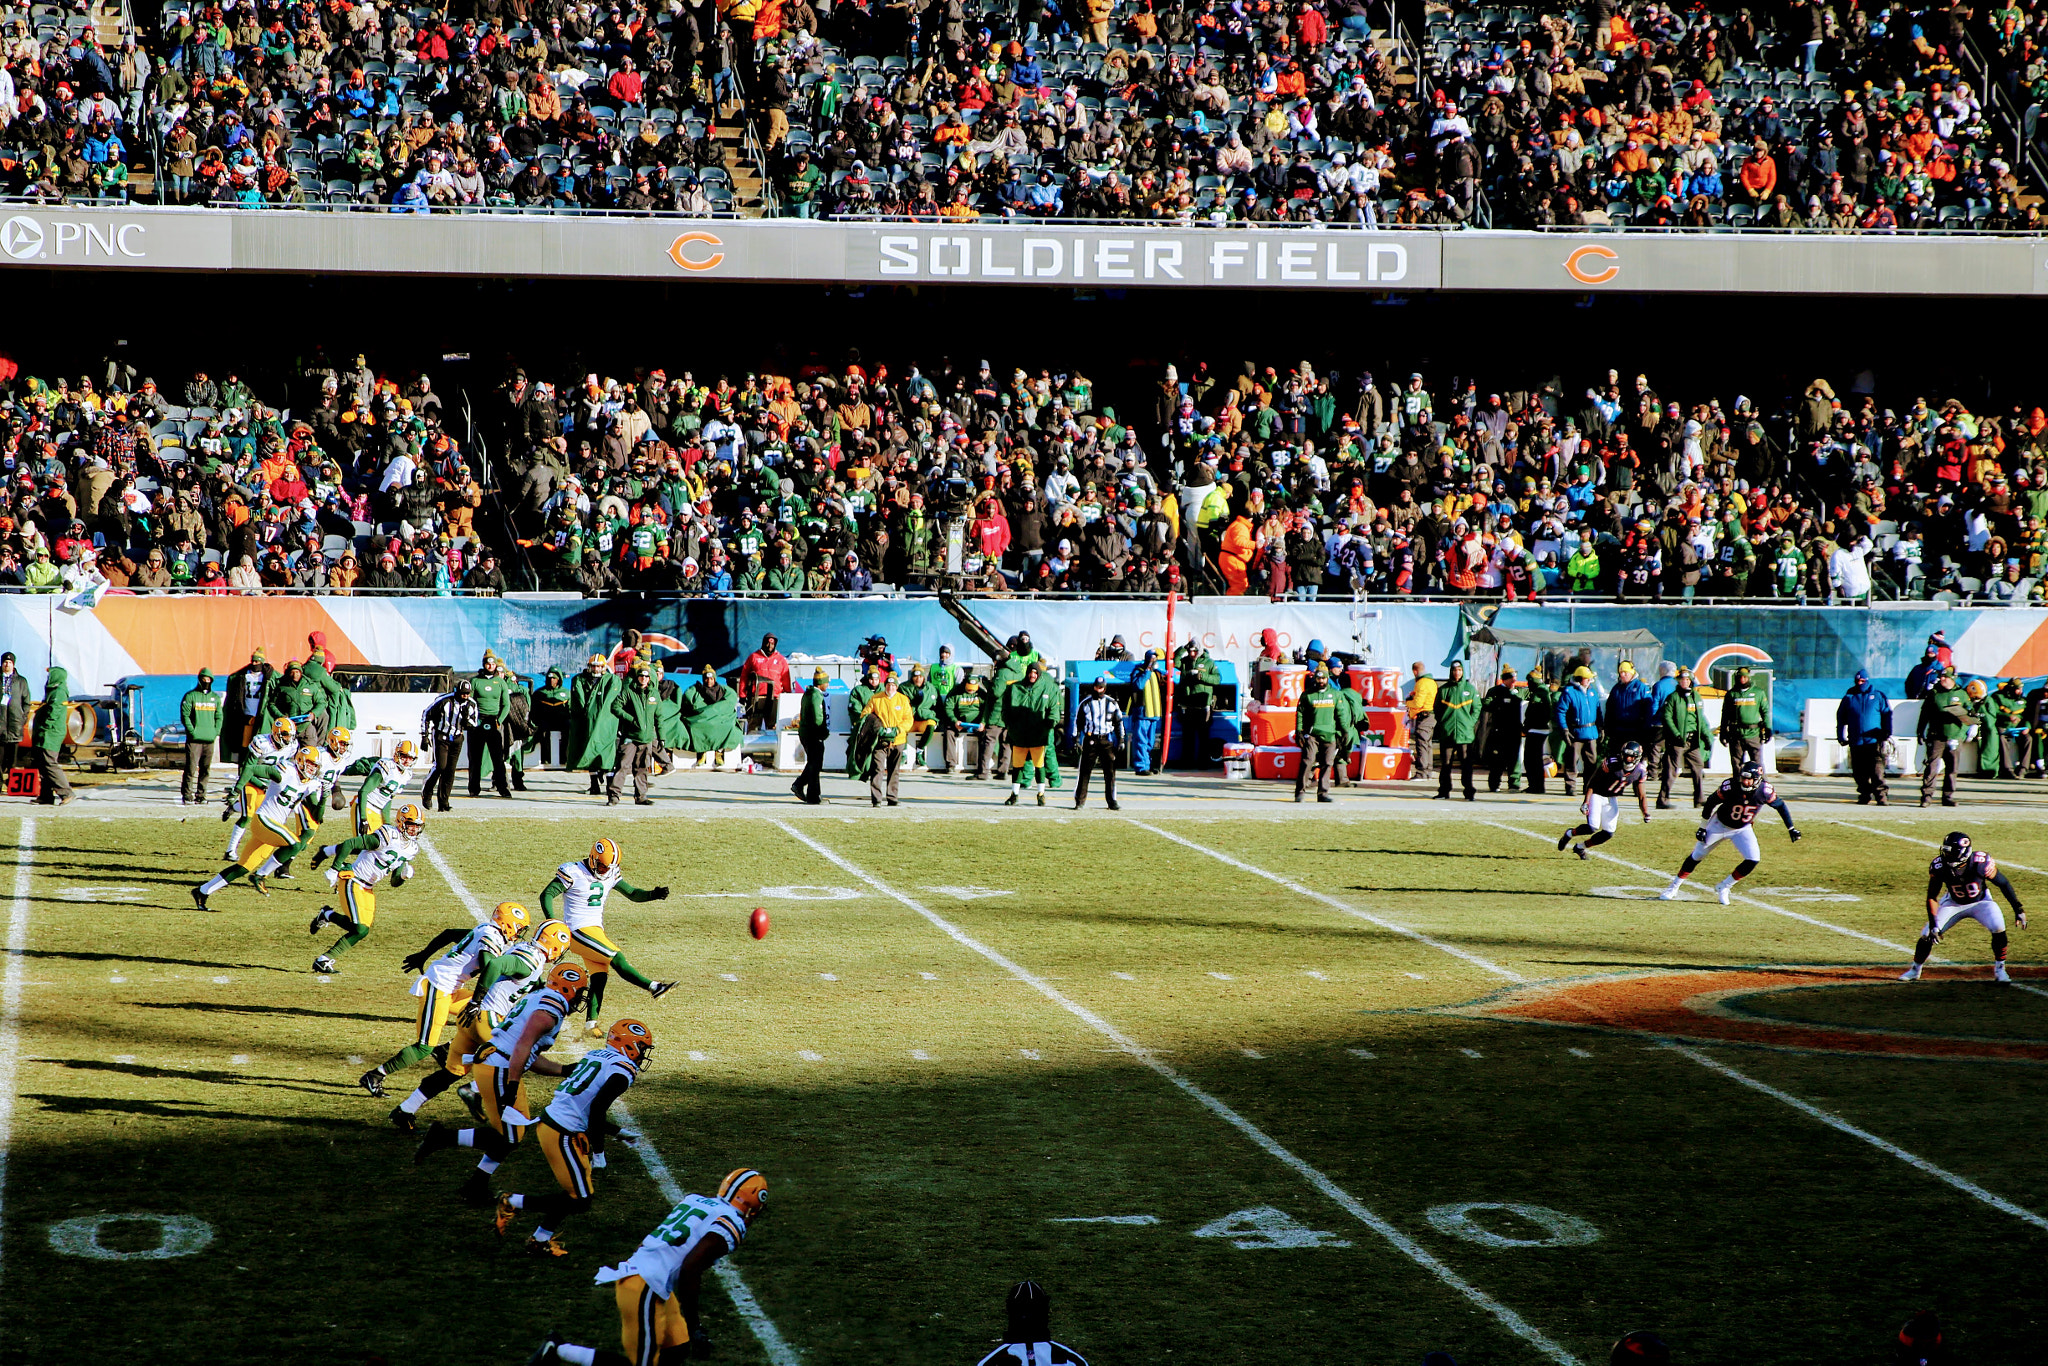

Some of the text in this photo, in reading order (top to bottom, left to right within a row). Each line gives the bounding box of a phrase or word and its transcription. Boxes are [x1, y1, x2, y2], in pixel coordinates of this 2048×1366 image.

[50, 222, 146, 257] PNC
[665, 230, 724, 272] C
[879, 235, 1408, 282] SOLDIER FIELD
[1562, 244, 1620, 284] C
[1406, 397, 1421, 414] 21
[1374, 457, 1392, 473] 27
[850, 495, 866, 513] 21
[778, 505, 793, 522] 12
[264, 525, 278, 543] 17
[740, 537, 758, 555] 12
[1720, 546, 1734, 562] 12
[1342, 548, 1357, 567] 23
[1509, 565, 1527, 581] 12
[1777, 557, 1798, 577] 76
[1632, 570, 1649, 584] 33
[1273, 755, 1285, 767] G
[1383, 755, 1395, 768] G
[10, 772, 35, 793] 30
[1730, 804, 1758, 823] 85
[587, 881, 604, 907] 2
[650, 1203, 709, 1247] 25
